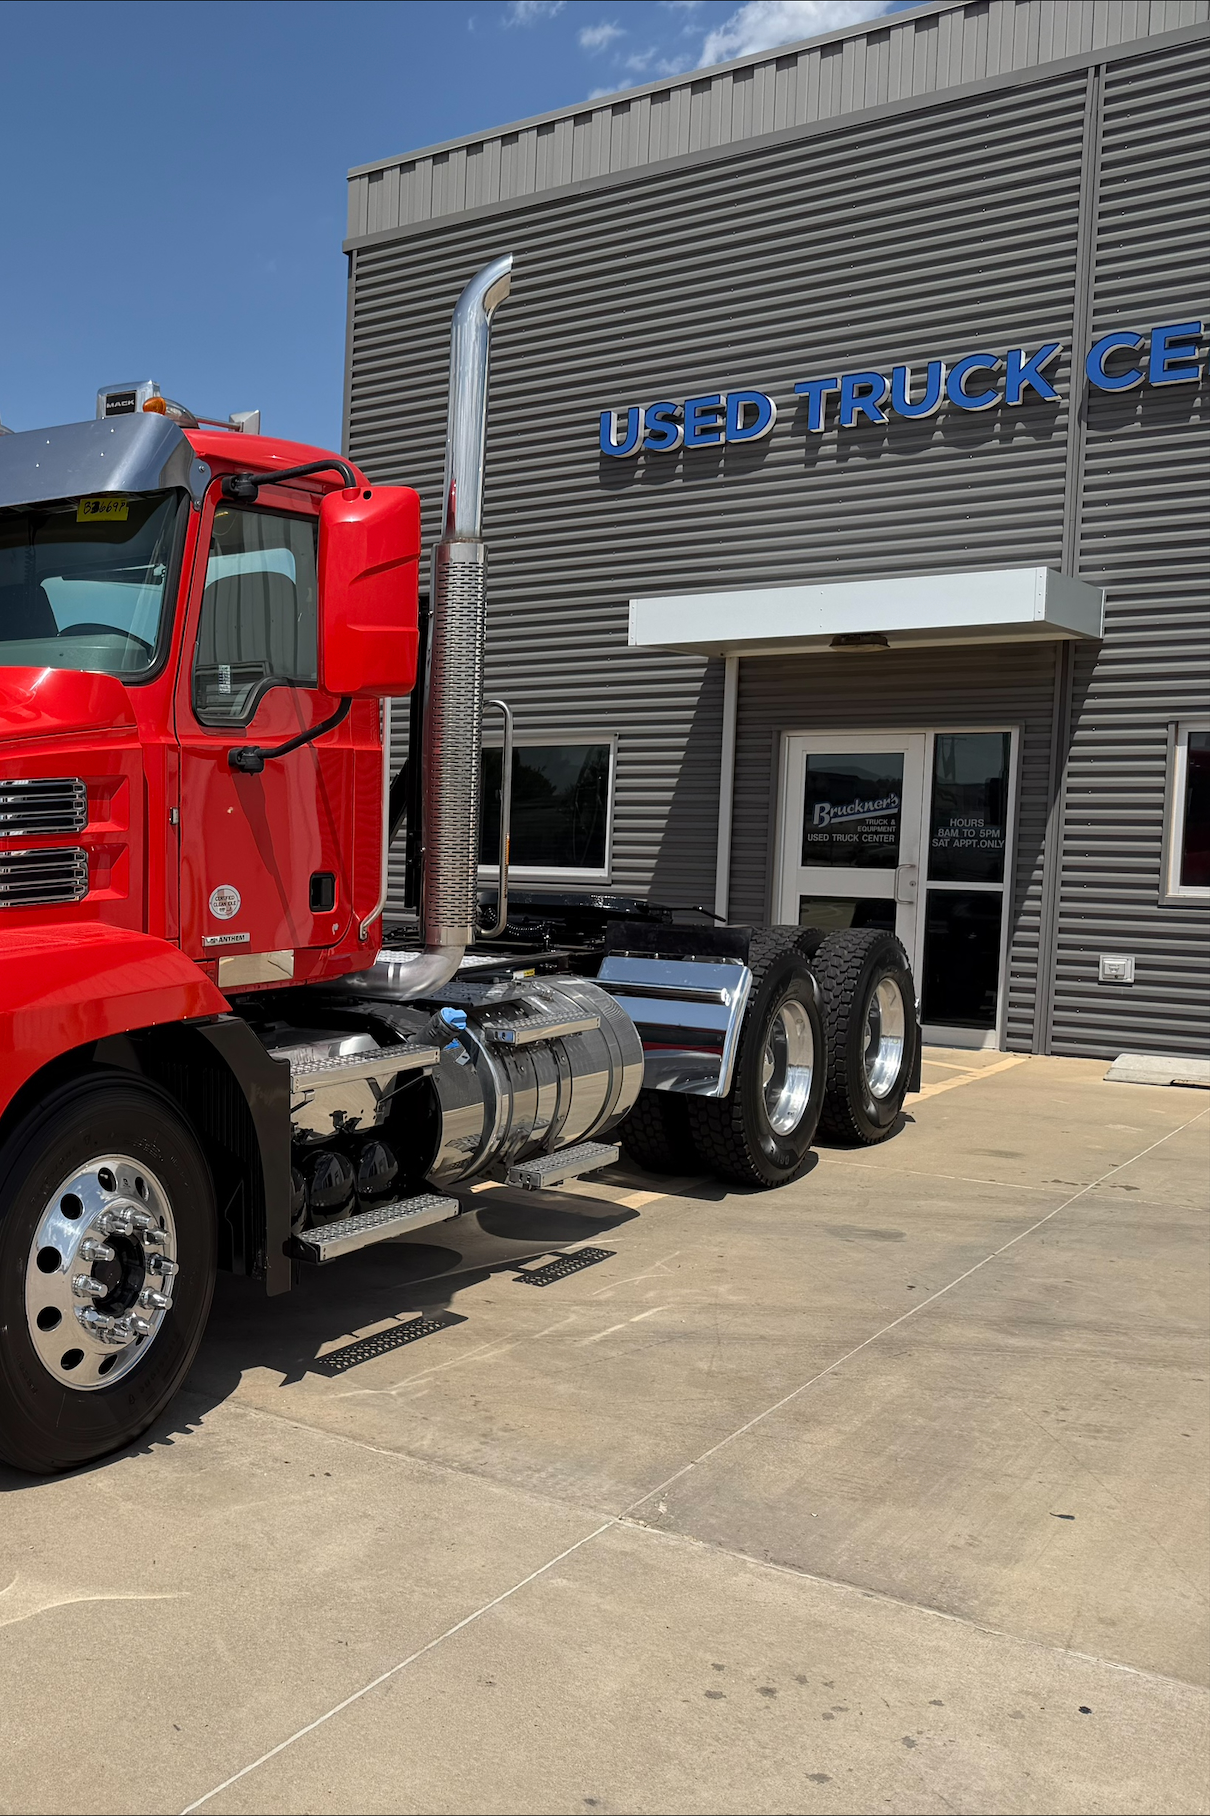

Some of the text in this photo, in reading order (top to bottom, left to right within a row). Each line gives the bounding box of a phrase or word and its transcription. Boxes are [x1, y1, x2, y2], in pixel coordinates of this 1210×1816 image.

[599, 320, 1210, 458] USED TRUCK CE
[106, 400, 135, 408] MACK
[813, 793, 899, 828] Bruckner's
[950, 818, 985, 828] HOURS
[807, 833, 896, 843] USED TRUCK CENTER
[938, 828, 1001, 838] 8AM TO 5PM
[932, 838, 950, 848] SAT
